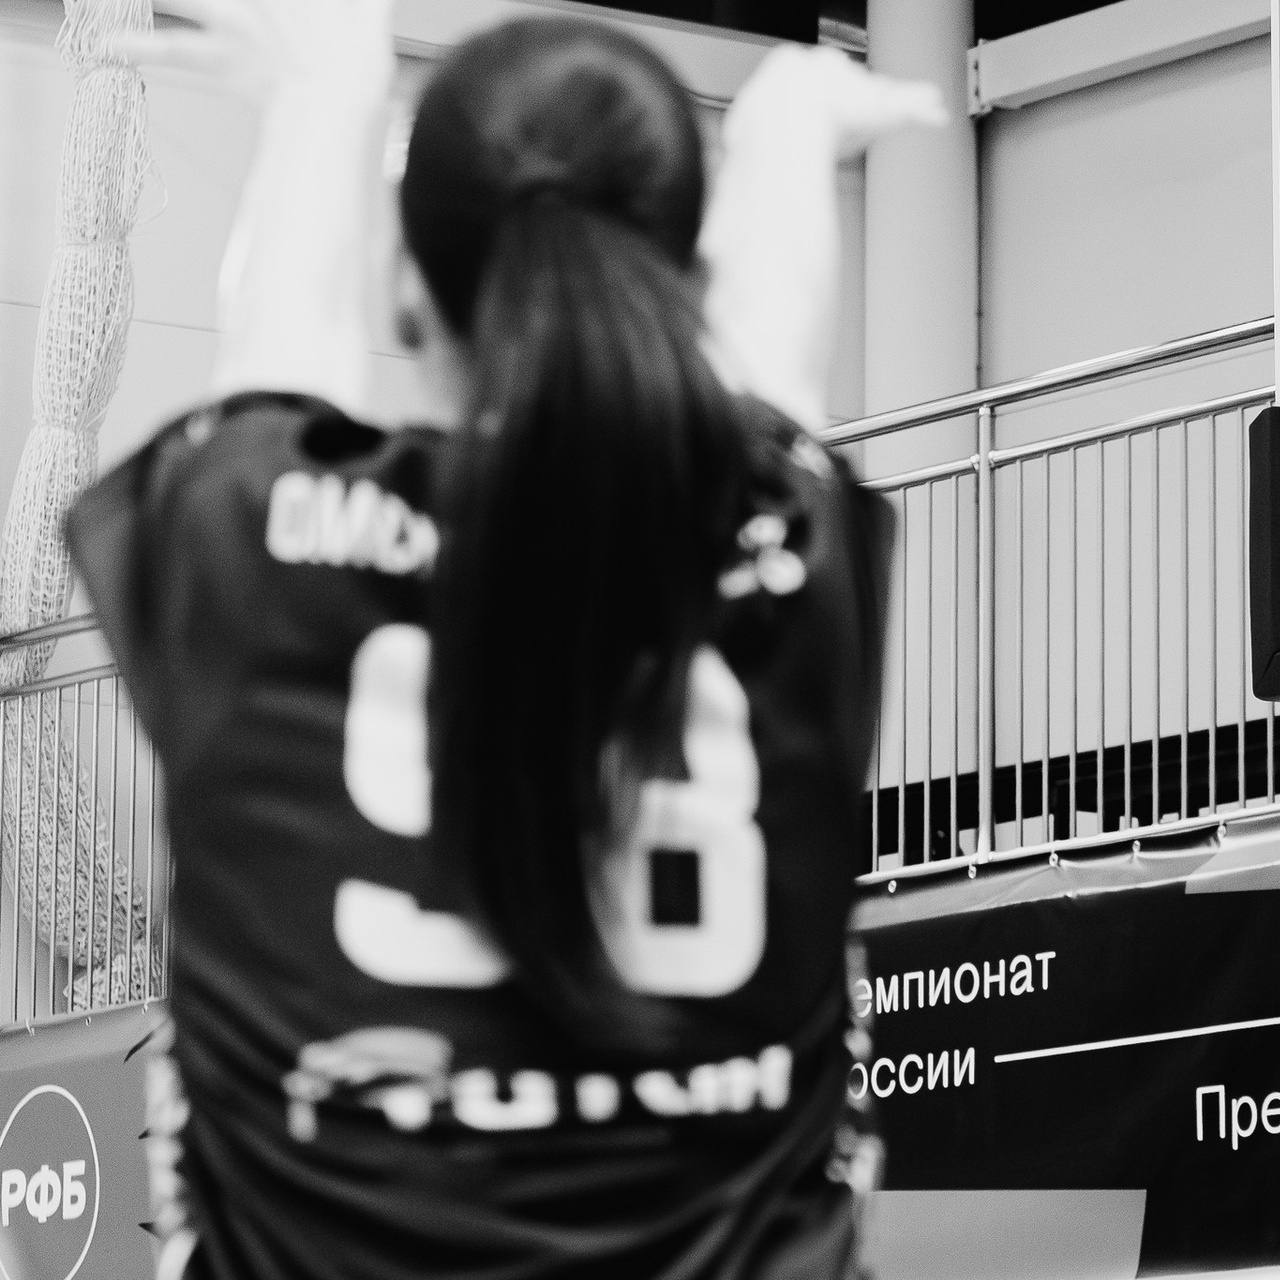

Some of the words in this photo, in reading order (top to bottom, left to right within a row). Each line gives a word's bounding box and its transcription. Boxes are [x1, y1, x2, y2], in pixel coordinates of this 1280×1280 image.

[853, 949, 1057, 1018] емпионат
[847, 1045, 976, 1100] оссии
[1, 1159, 87, 1227] РФБ
